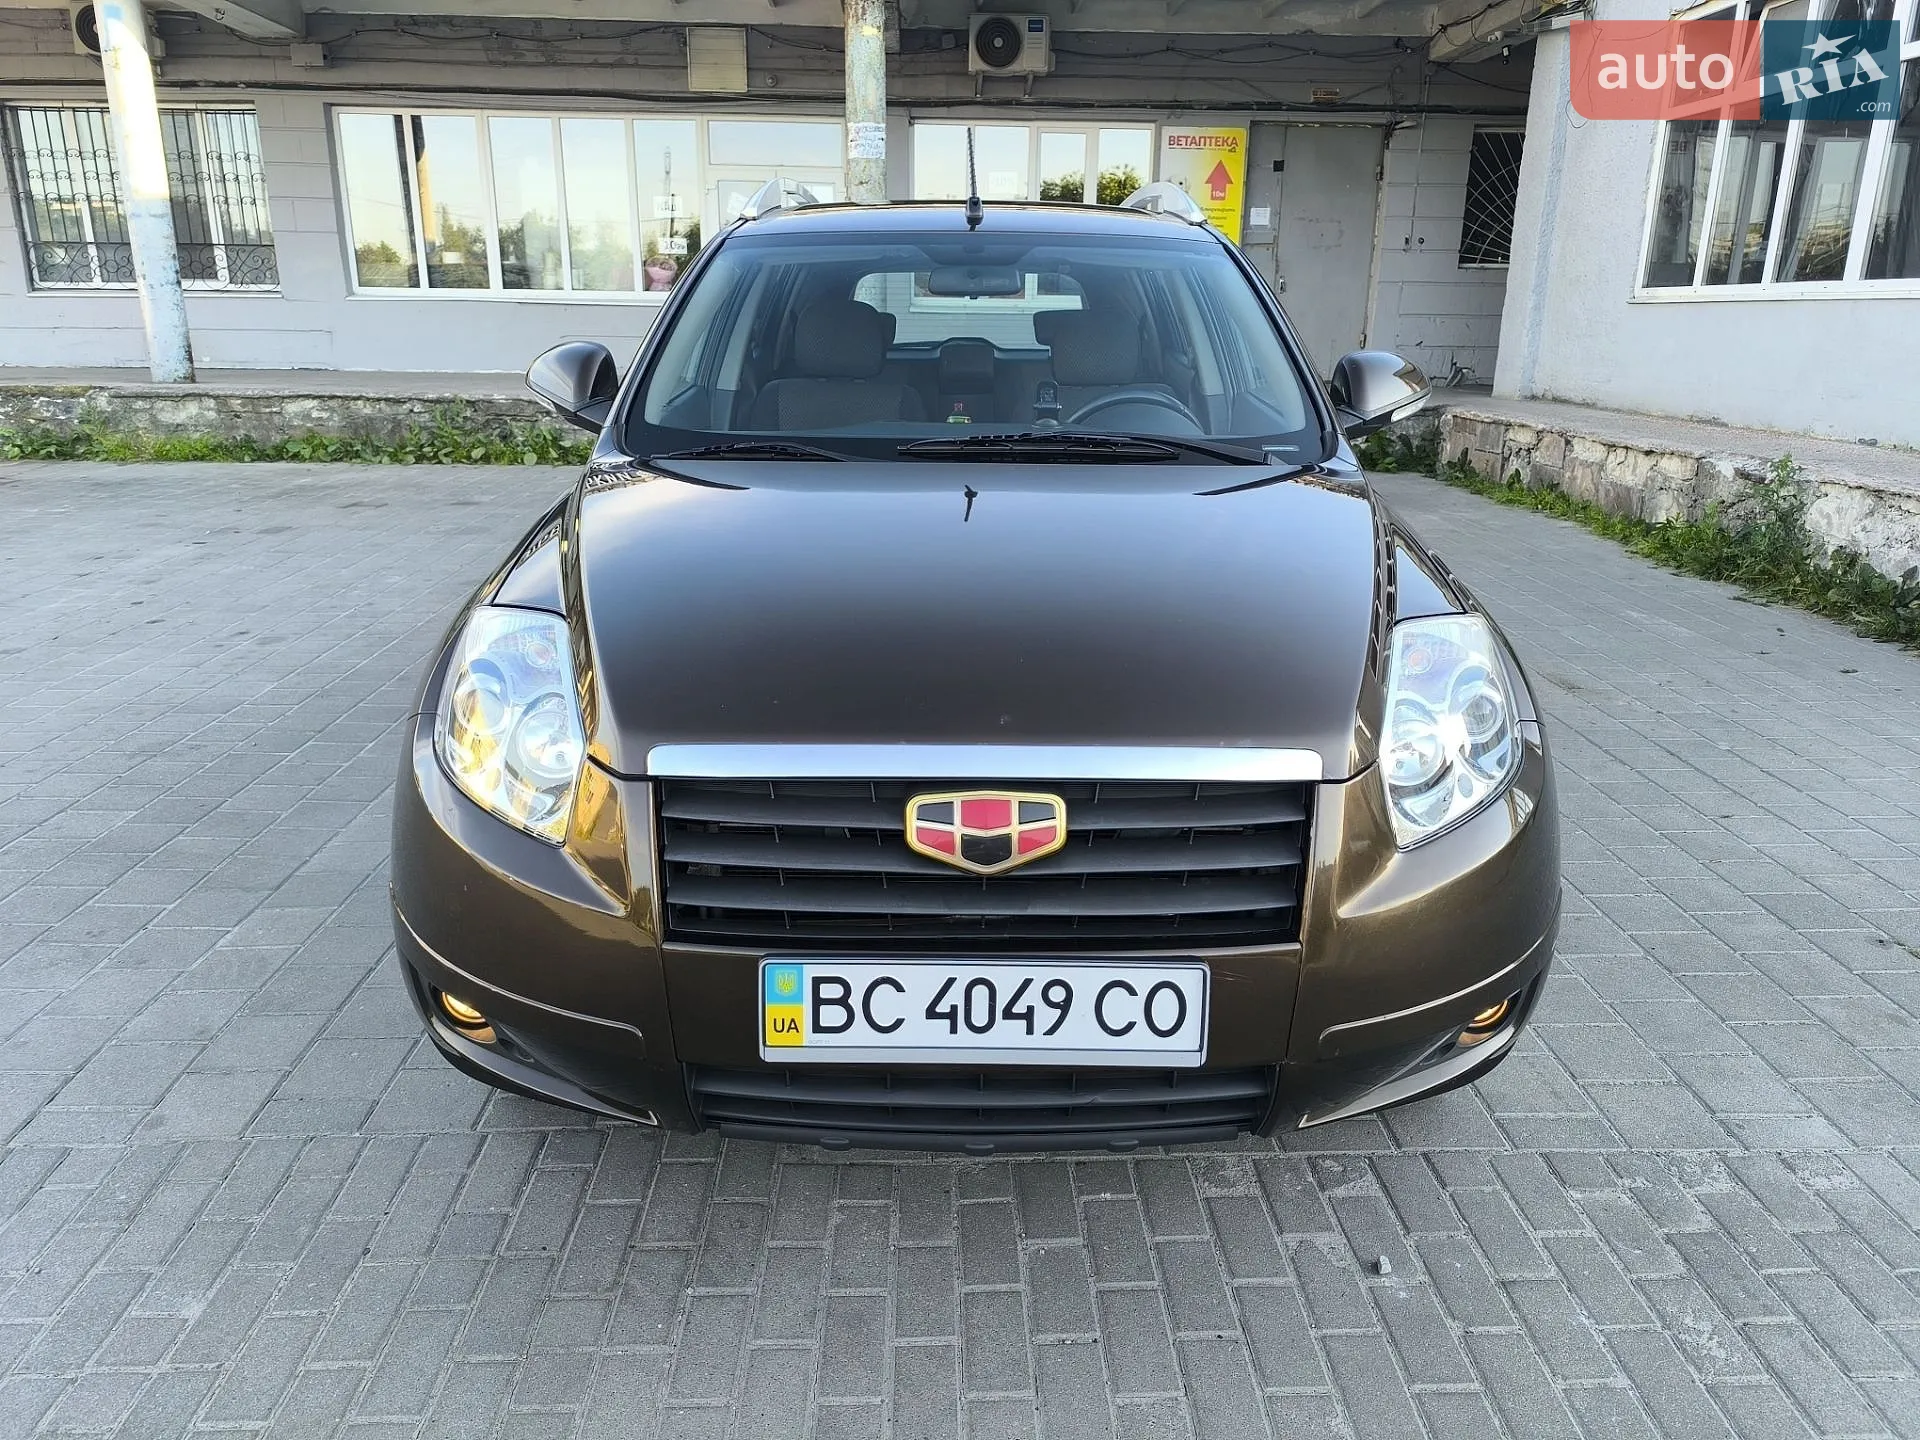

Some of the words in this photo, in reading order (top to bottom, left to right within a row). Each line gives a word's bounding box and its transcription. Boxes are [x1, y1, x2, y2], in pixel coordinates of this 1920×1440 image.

[1168, 135, 1239, 147] ВЕТАПТЕКА
[811, 975, 906, 1034] BC
[925, 976, 1074, 1036] 4049
[1094, 979, 1187, 1039] CO
[773, 1018, 800, 1033] UA
